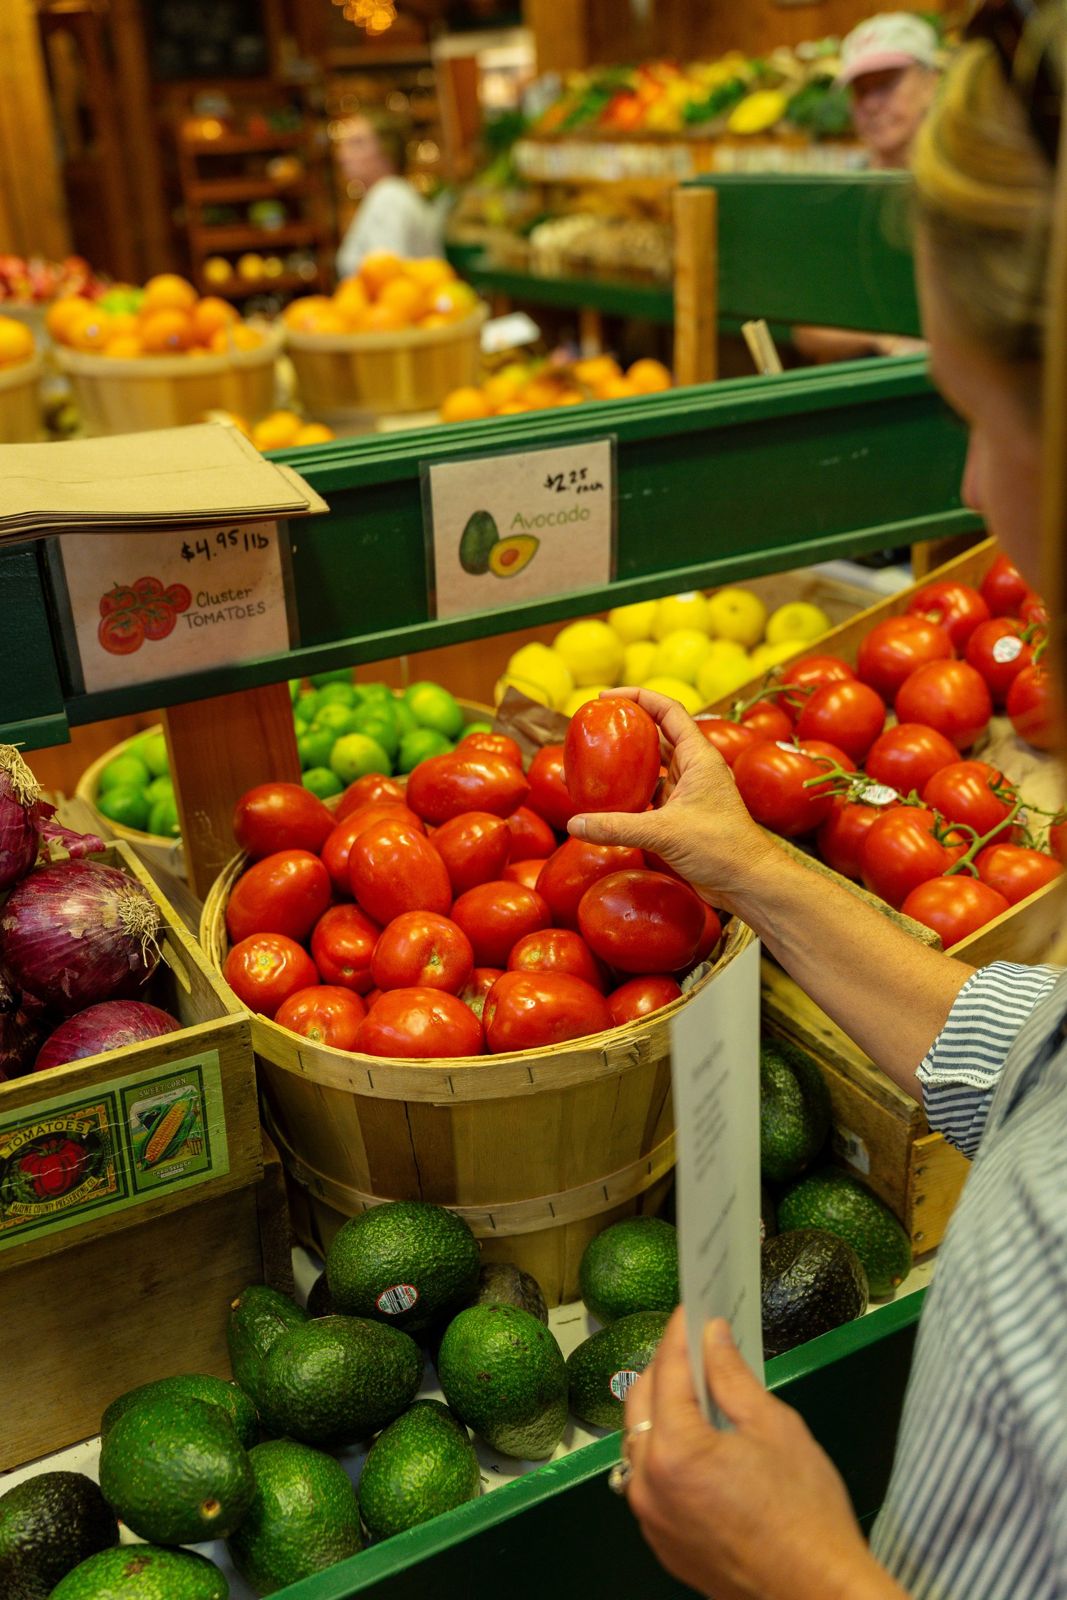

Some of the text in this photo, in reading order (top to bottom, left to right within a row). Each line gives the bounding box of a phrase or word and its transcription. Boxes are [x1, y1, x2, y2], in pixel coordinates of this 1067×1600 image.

[510, 505, 591, 530] Avocado
[196, 587, 253, 608] Cluster
[182, 602, 266, 629] TOMATOES
[6, 1121, 85, 1152] TOMATOES
